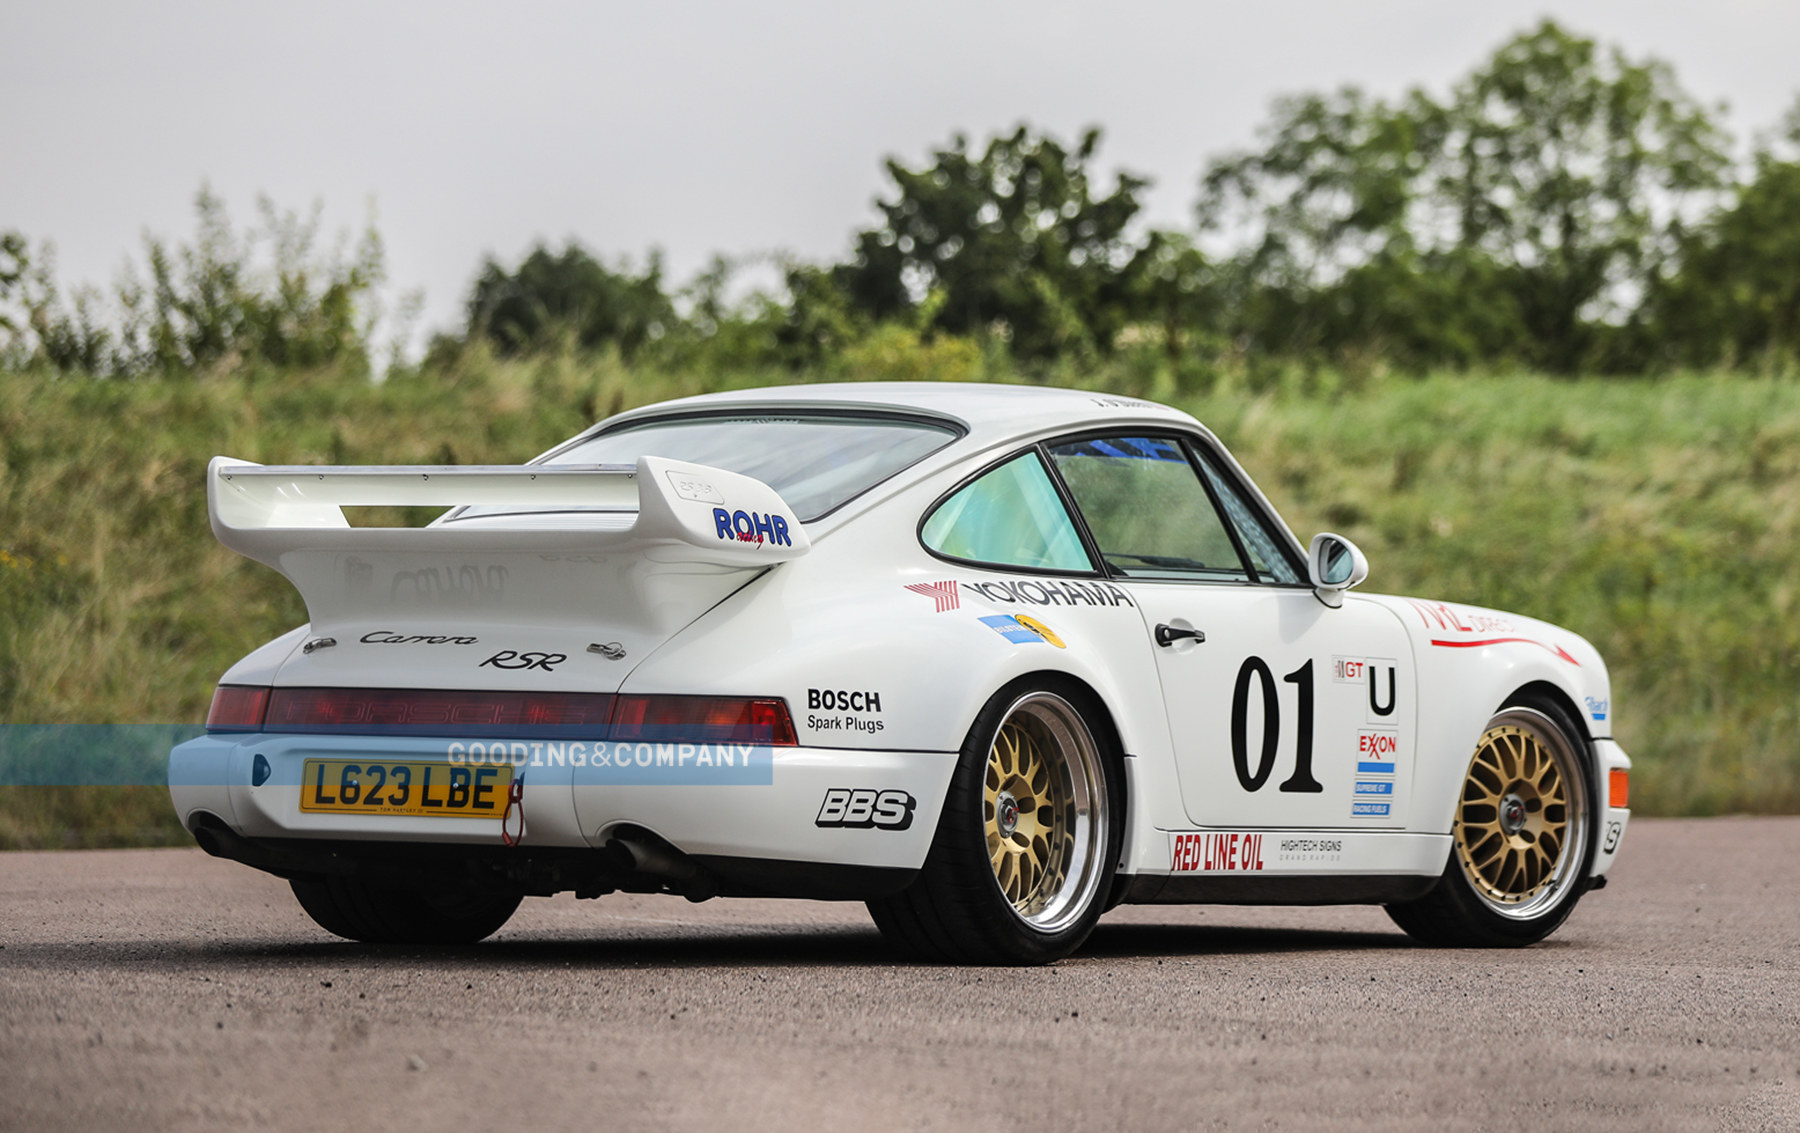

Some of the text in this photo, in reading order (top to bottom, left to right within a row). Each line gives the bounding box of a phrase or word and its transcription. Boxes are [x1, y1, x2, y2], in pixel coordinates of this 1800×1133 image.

[712, 507, 792, 547] ROHR
[961, 580, 1134, 608] YOKOHAMA
[359, 631, 479, 645] Carrera
[478, 650, 567, 672] RSR
[807, 688, 882, 713] BOSCH
[1368, 665, 1396, 717] U
[807, 714, 884, 734] Spark Plugs
[1230, 655, 1324, 793] 01
[1359, 733, 1396, 760] EXXON
[315, 763, 498, 810] L623 LBE
[815, 788, 917, 831] BBS
[1172, 834, 1263, 871] RED LINE OIL
[1280, 840, 1342, 852] HIGHTECH SIGNS
